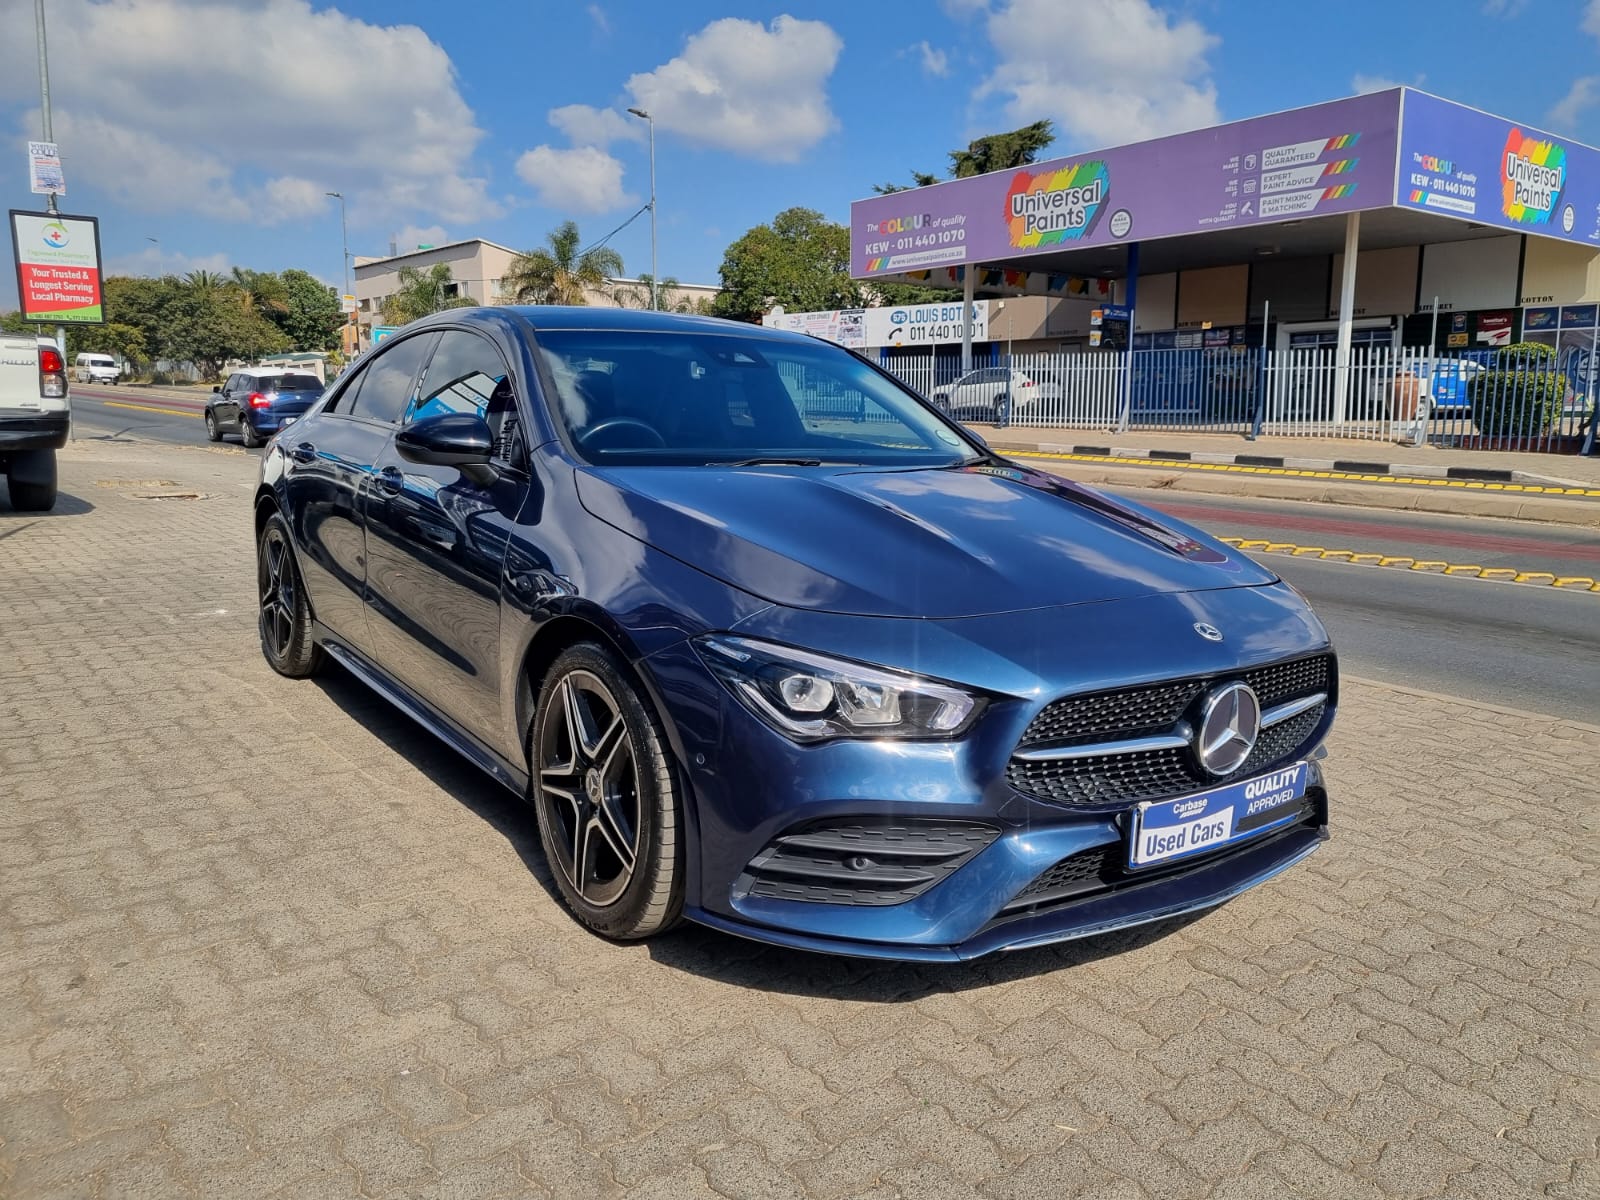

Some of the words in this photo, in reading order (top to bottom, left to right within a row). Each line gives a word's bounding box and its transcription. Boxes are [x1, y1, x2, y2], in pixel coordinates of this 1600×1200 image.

[1264, 147, 1296, 159] QUALITY
[1264, 152, 1316, 166] GUARANTEED
[1264, 172, 1292, 183] EXPERT
[1508, 155, 1561, 190] Universal
[1263, 181, 1285, 190] PAINT
[1286, 176, 1315, 187] ADVICE
[1411, 173, 1429, 187] KEW
[1433, 178, 1444, 191] 011
[1459, 184, 1475, 198] 1070
[1013, 181, 1100, 216] Universal
[1262, 197, 1284, 206] PAINT
[1285, 193, 1312, 203] MIXING
[1515, 182, 1551, 209] Paints
[1268, 202, 1307, 213] MATCHING
[867, 223, 879, 233] The
[879, 213, 932, 235] COLOUR
[932, 217, 941, 228] of
[941, 214, 966, 228] quality
[1027, 207, 1084, 234] Paints
[865, 240, 890, 255] KEW
[897, 237, 913, 250] 011
[915, 233, 936, 247] 440
[938, 229, 966, 243] 1070
[31, 267, 50, 278] Your
[51, 269, 81, 280] Trusted
[82, 271, 89, 280] &
[30, 280, 62, 291] Longest
[63, 281, 94, 293] Serving
[31, 292, 53, 301] Local
[54, 293, 94, 304] Pharmacy
[892, 313, 906, 322] 575
[909, 308, 939, 324] LOUIS
[941, 306, 977, 322] BOTA
[910, 326, 926, 340] 011
[929, 325, 950, 339] 440
[1244, 767, 1300, 799] QUALITY
[1173, 798, 1208, 815] Carbase
[1246, 788, 1294, 815] APPROVED
[1146, 830, 1185, 857] Used
[1190, 820, 1225, 844] Cars
